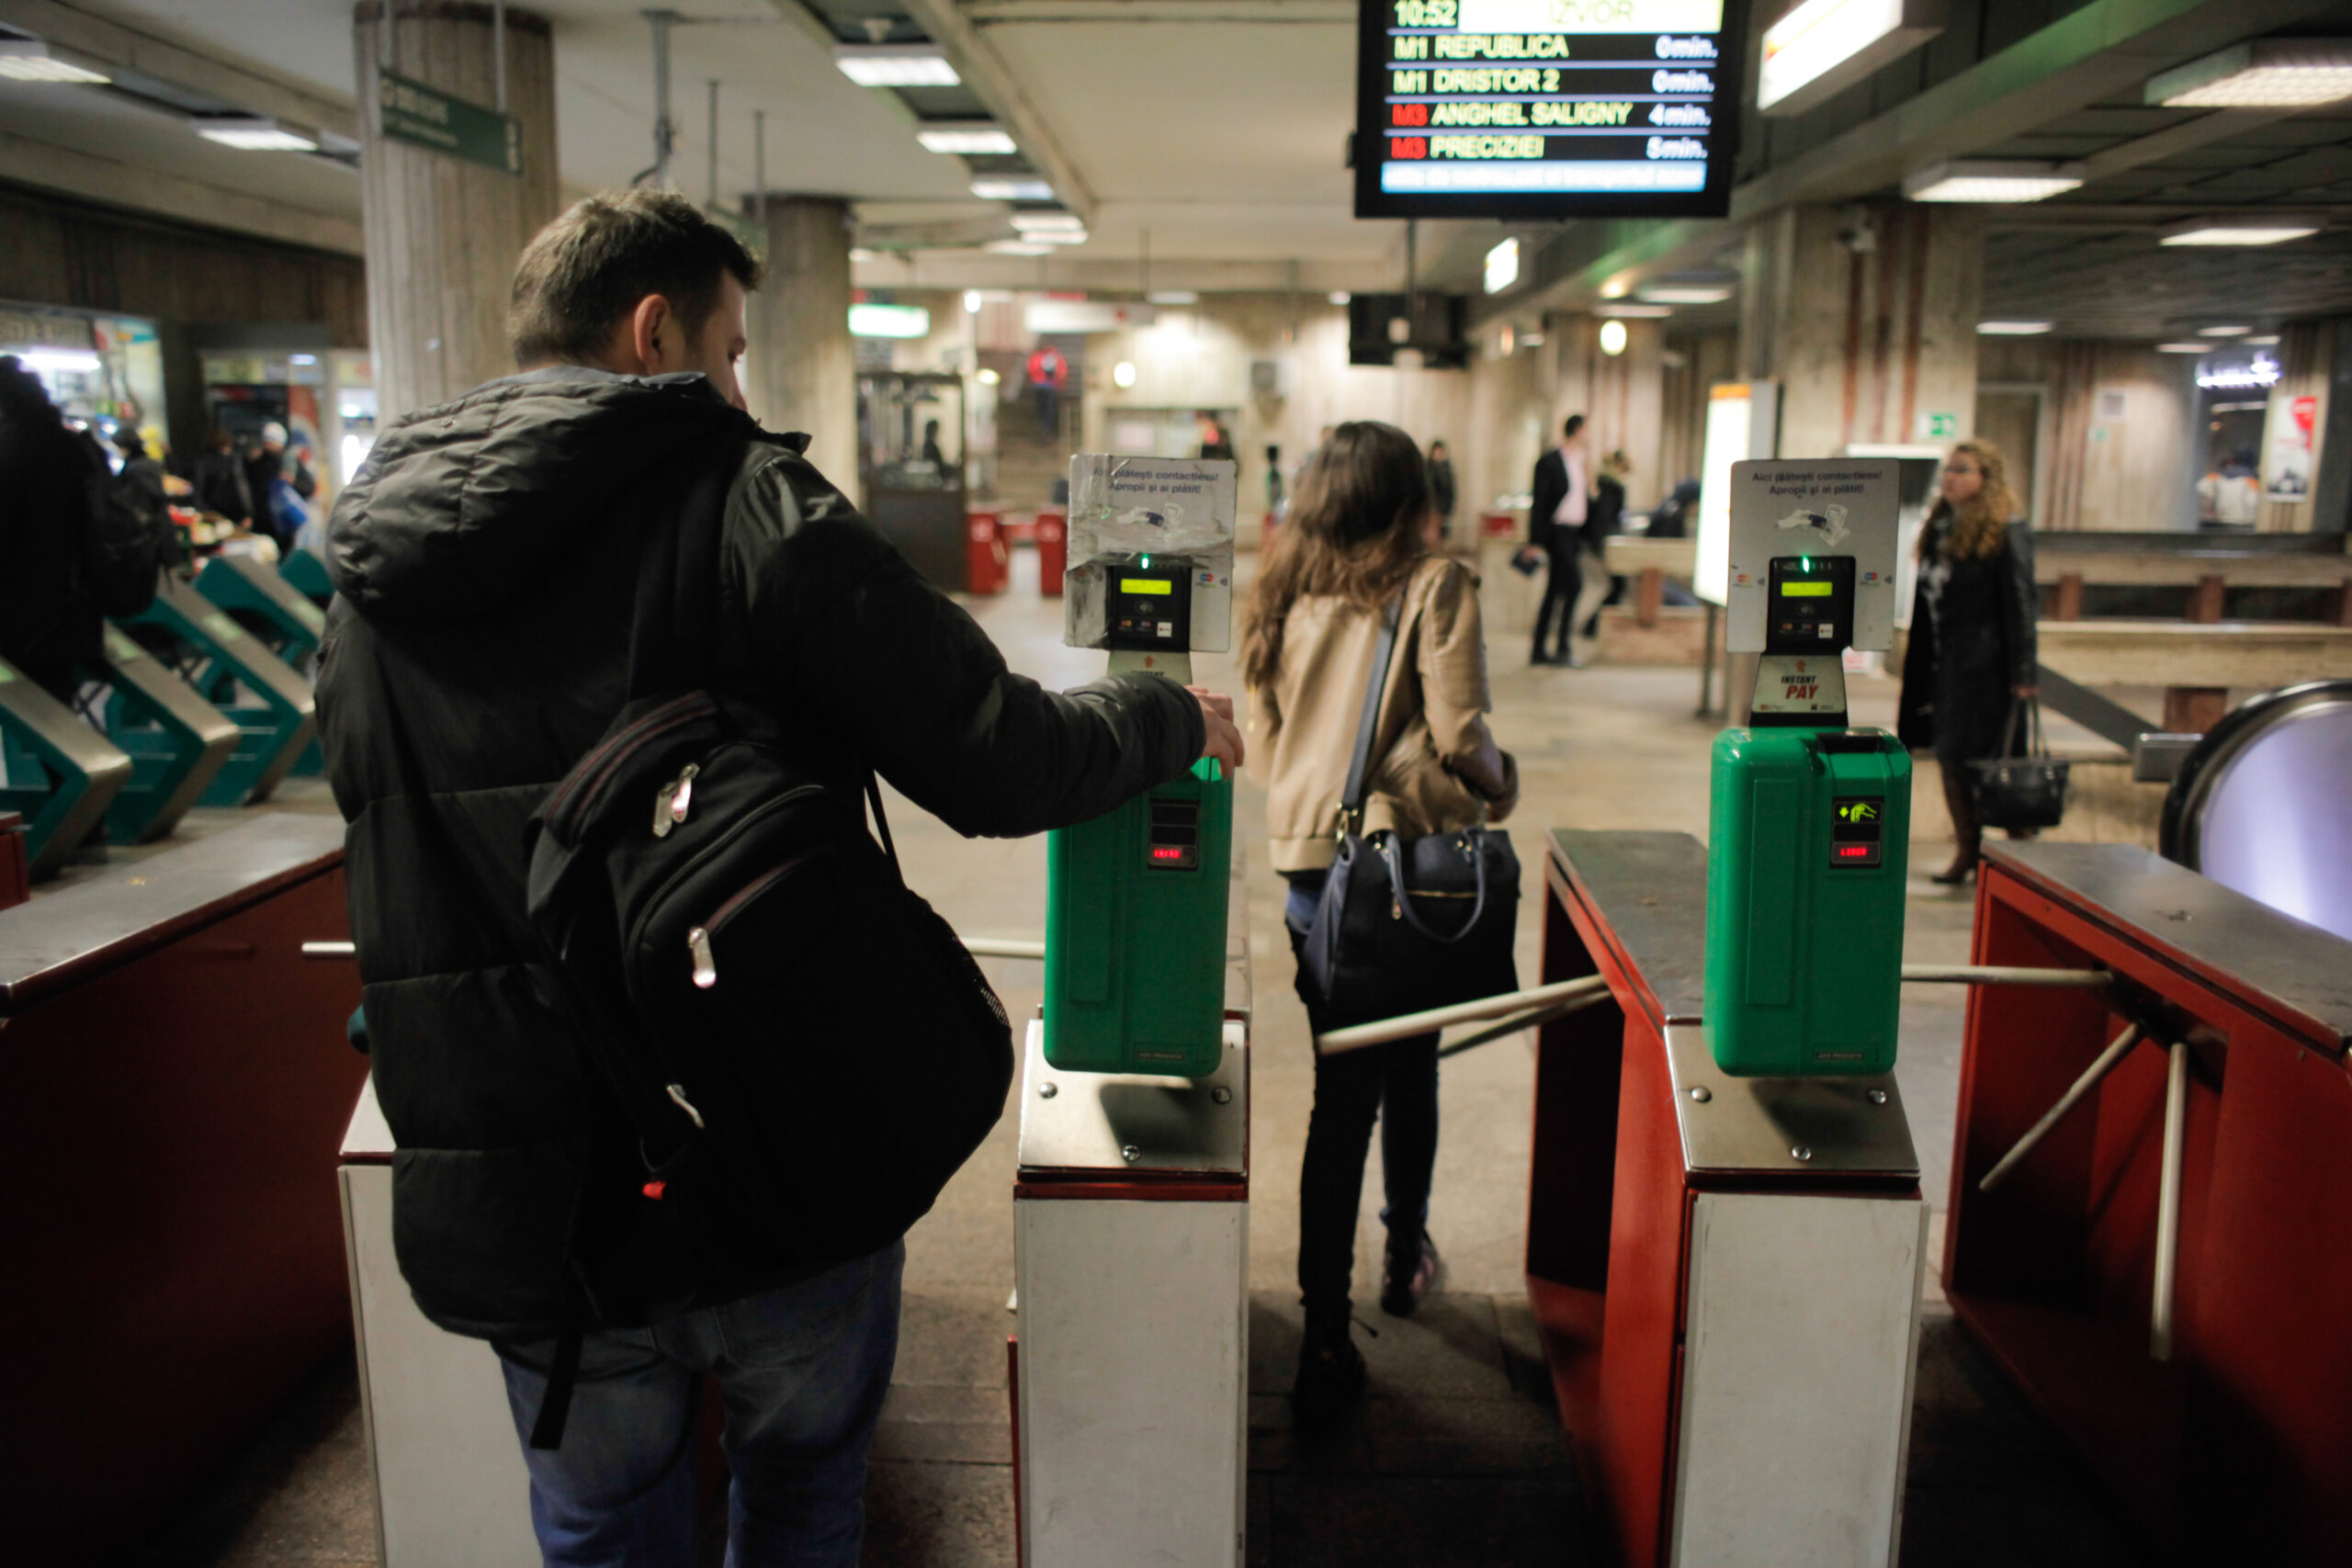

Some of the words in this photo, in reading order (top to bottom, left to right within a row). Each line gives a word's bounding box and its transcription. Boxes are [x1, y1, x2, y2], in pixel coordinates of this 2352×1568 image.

[1394, 0, 1459, 27] 10:52
[1547, 0, 1634, 24] IZVOR
[1394, 36, 1429, 60] M1
[1434, 34, 1569, 59] REPUBLICA
[1393, 70, 1428, 94] M1
[1433, 69, 1541, 93] DRISTOR
[1542, 68, 1560, 92] 2
[1392, 104, 1428, 127] M3
[1430, 102, 1529, 126] ANGHEL
[1531, 102, 1634, 126] SALIGNY
[1391, 136, 1427, 159] M3
[1430, 135, 1545, 159] PRECIZIEI
[1752, 472, 1772, 481] Aici
[1781, 675, 1816, 684] INSTANT
[1785, 684, 1819, 700] PAY
